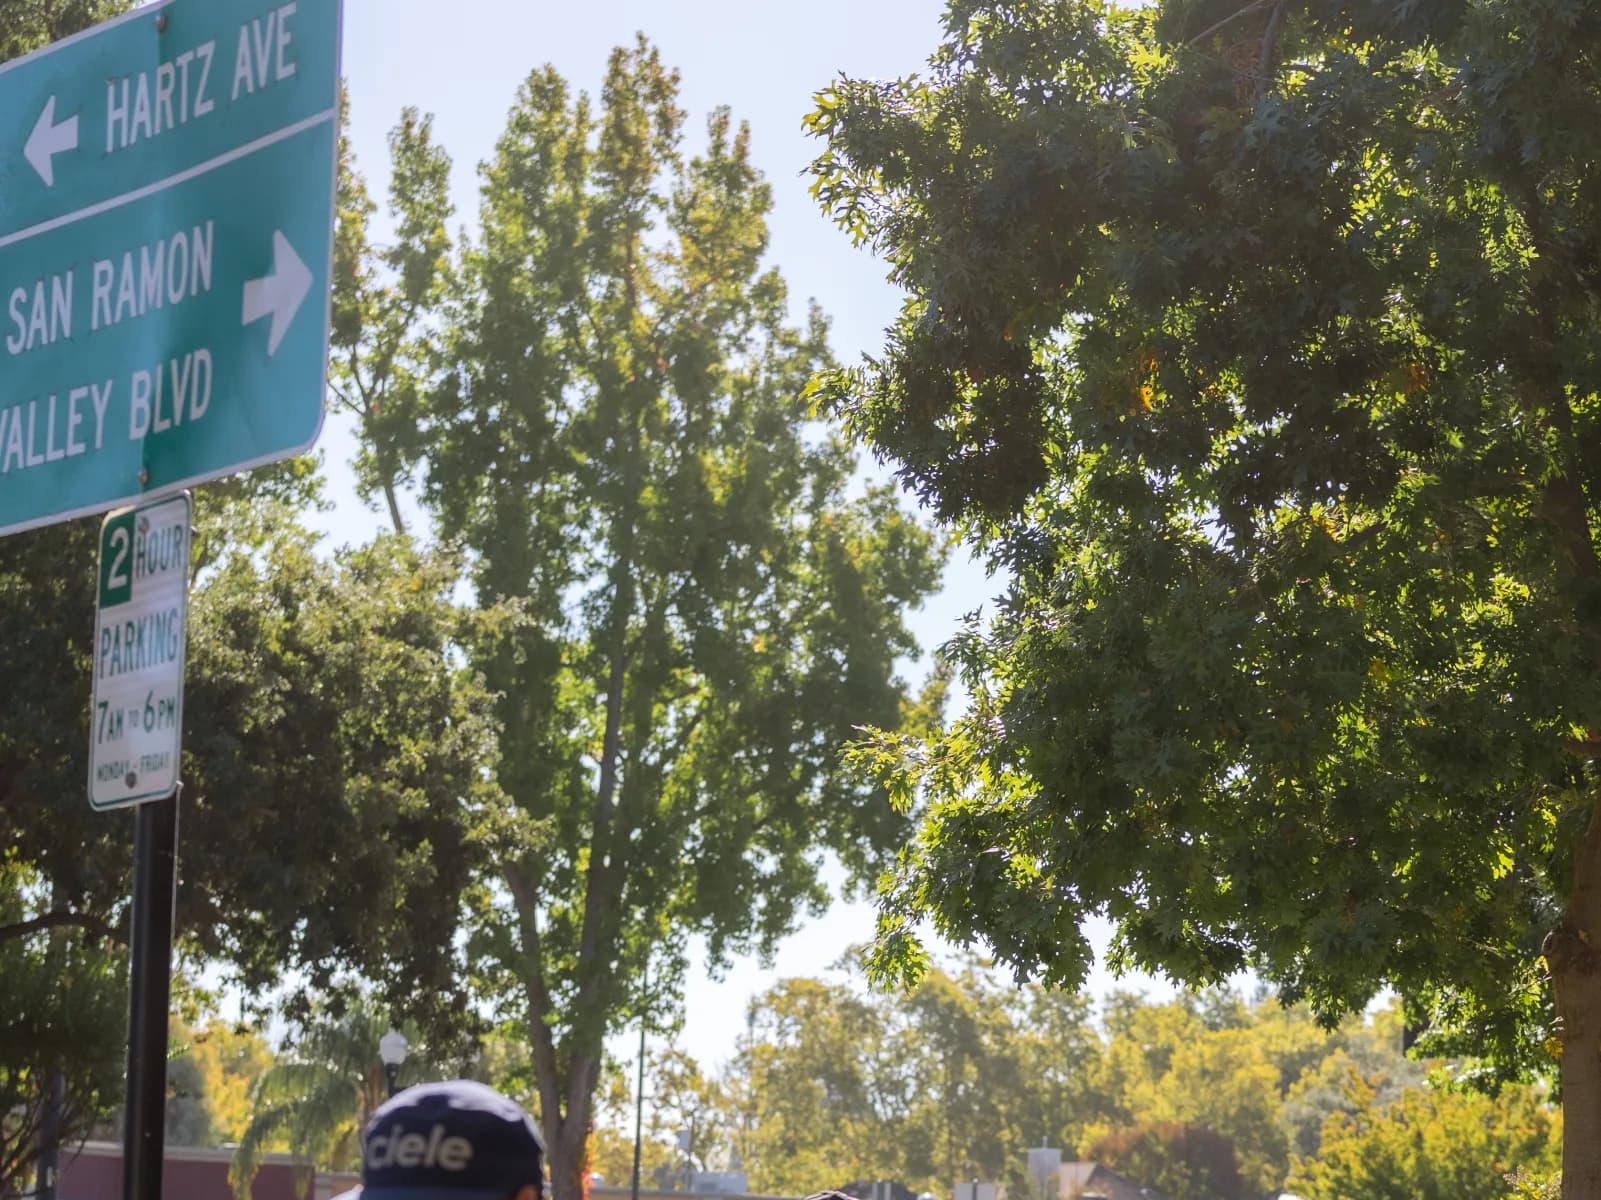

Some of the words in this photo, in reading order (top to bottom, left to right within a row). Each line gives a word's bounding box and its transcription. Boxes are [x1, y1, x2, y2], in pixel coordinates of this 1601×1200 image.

[106, 40, 216, 153] HARTZ
[231, 3, 297, 100] AVE
[7, 270, 73, 355] SAN
[91, 221, 214, 331] RAMON
[129, 349, 213, 440] BLVD
[107, 527, 129, 590] 2
[135, 525, 183, 579] HOUR
[100, 607, 178, 679] PARKING
[367, 1124, 473, 1171] ciele
